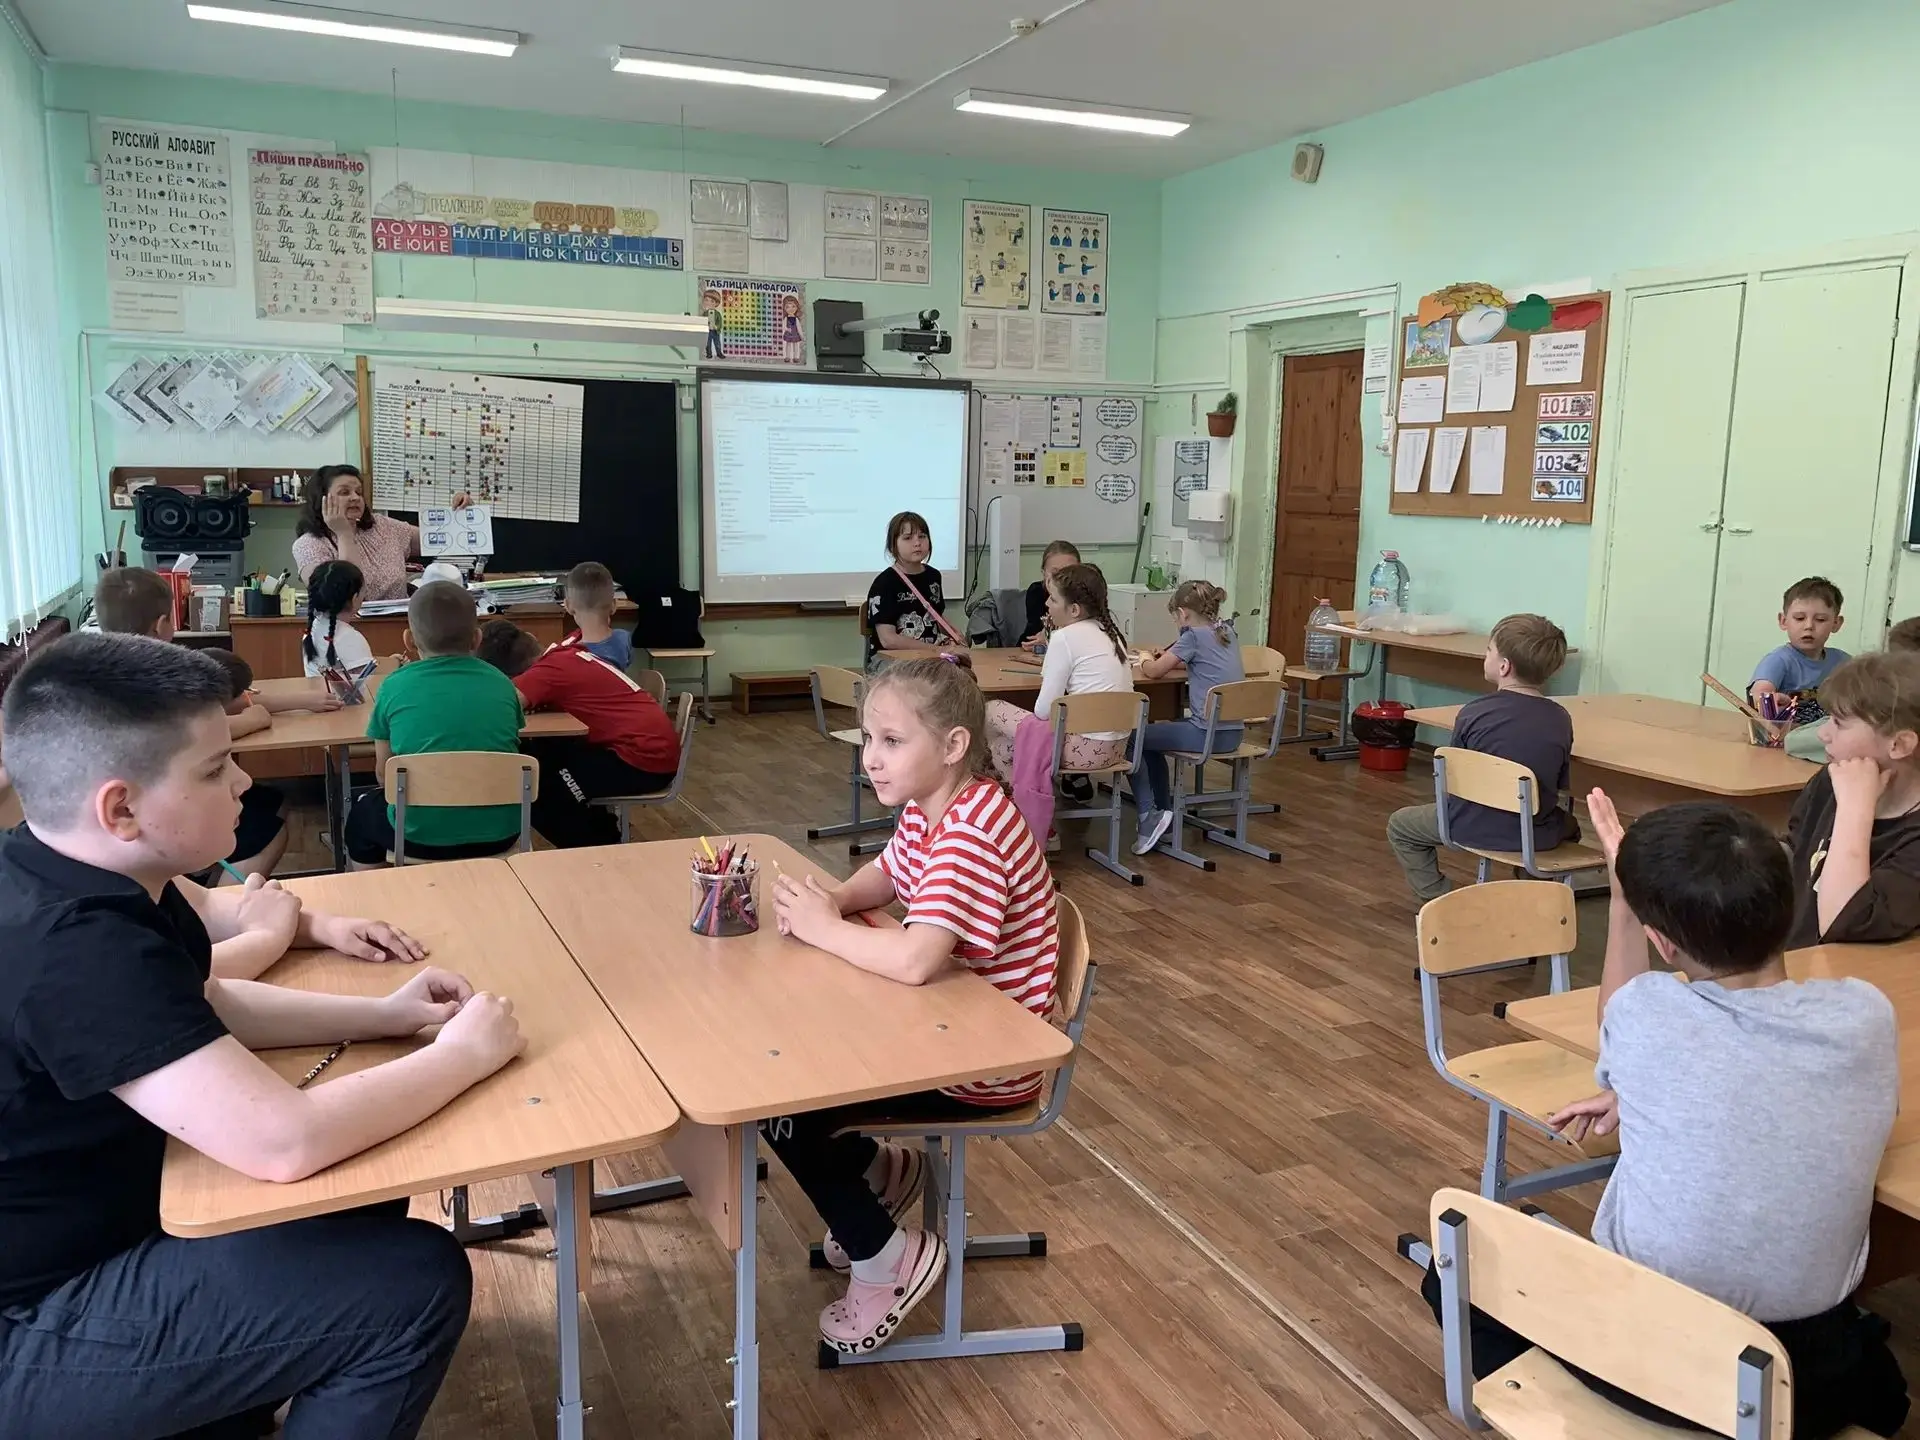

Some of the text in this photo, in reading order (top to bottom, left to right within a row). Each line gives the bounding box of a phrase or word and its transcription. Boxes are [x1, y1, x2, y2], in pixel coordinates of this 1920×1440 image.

[112, 130, 215, 155] РУССКИЙ АЛФАВИТ
[105, 154, 121, 164] Аа
[136, 156, 152, 167] Бб
[138, 205, 158, 215] Мм
[199, 210, 218, 220] Оо
[139, 220, 156, 233] Рр
[170, 223, 186, 233] Сс
[200, 225, 216, 236] Тт
[109, 233, 128, 247] Уу
[139, 236, 160, 250] Фф
[171, 238, 189, 249] Хх
[884, 247, 895, 255] 35
[906, 249, 912, 257] 5
[922, 250, 927, 258] 7
[705, 280, 797, 292] ТАБЛИЦА ПИФАГОРА
[1542, 398, 1568, 414] 101
[1562, 424, 1589, 440] 102
[1537, 455, 1564, 471] 103
[1558, 480, 1581, 495] 104
